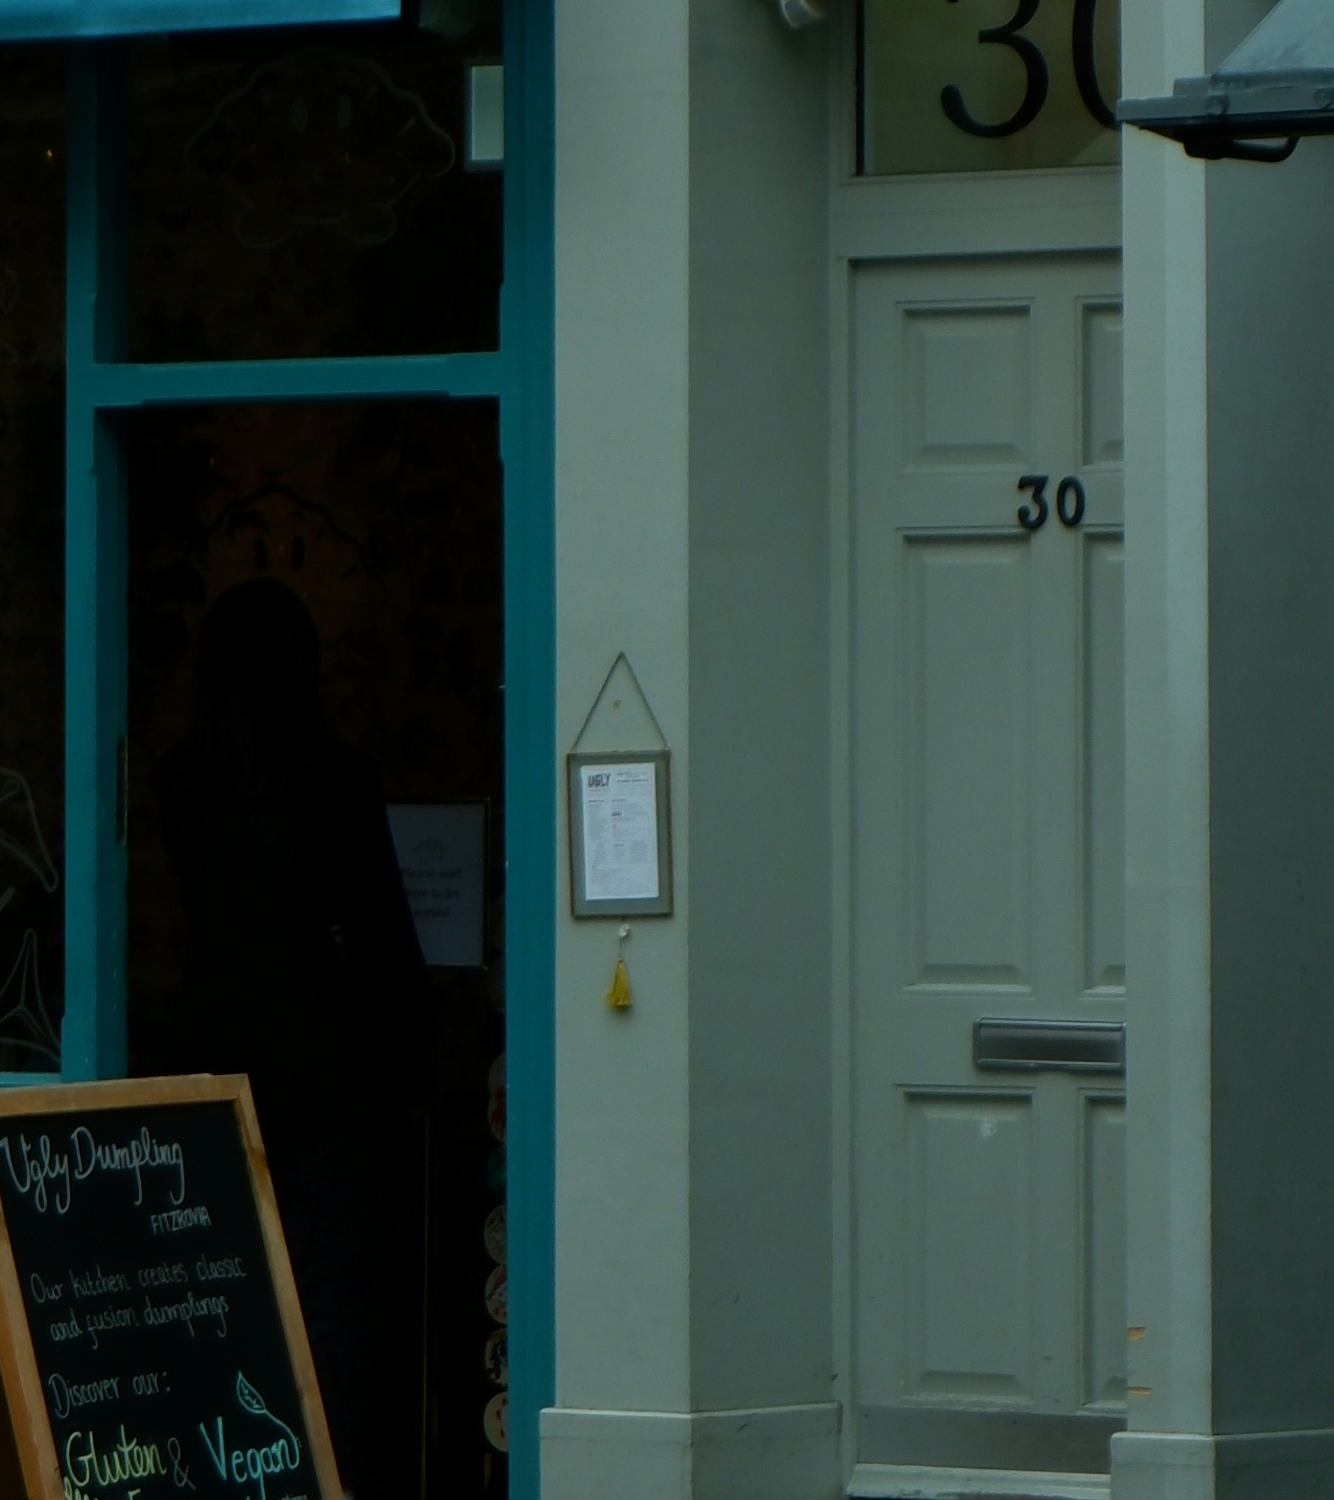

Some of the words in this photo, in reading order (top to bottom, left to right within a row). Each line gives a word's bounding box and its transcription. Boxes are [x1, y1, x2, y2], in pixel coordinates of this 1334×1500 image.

[1018, 475, 1085, 529] 30
[587, 772, 612, 789] UGLY
[0, 1133, 71, 1214] Ugly
[71, 1126, 185, 1206] Dumpling
[150, 1205, 212, 1235] FITZROVIA
[30, 1273, 64, 1303] Our
[137, 1261, 188, 1287] creates
[196, 1253, 247, 1280] classic
[50, 1307, 83, 1341] and
[86, 1305, 139, 1349] fusion
[144, 1291, 230, 1338] dumplings
[48, 1373, 119, 1419] Discover
[132, 1371, 171, 1396] our:
[66, 1424, 168, 1487] Gluten
[168, 1437, 197, 1491] &
